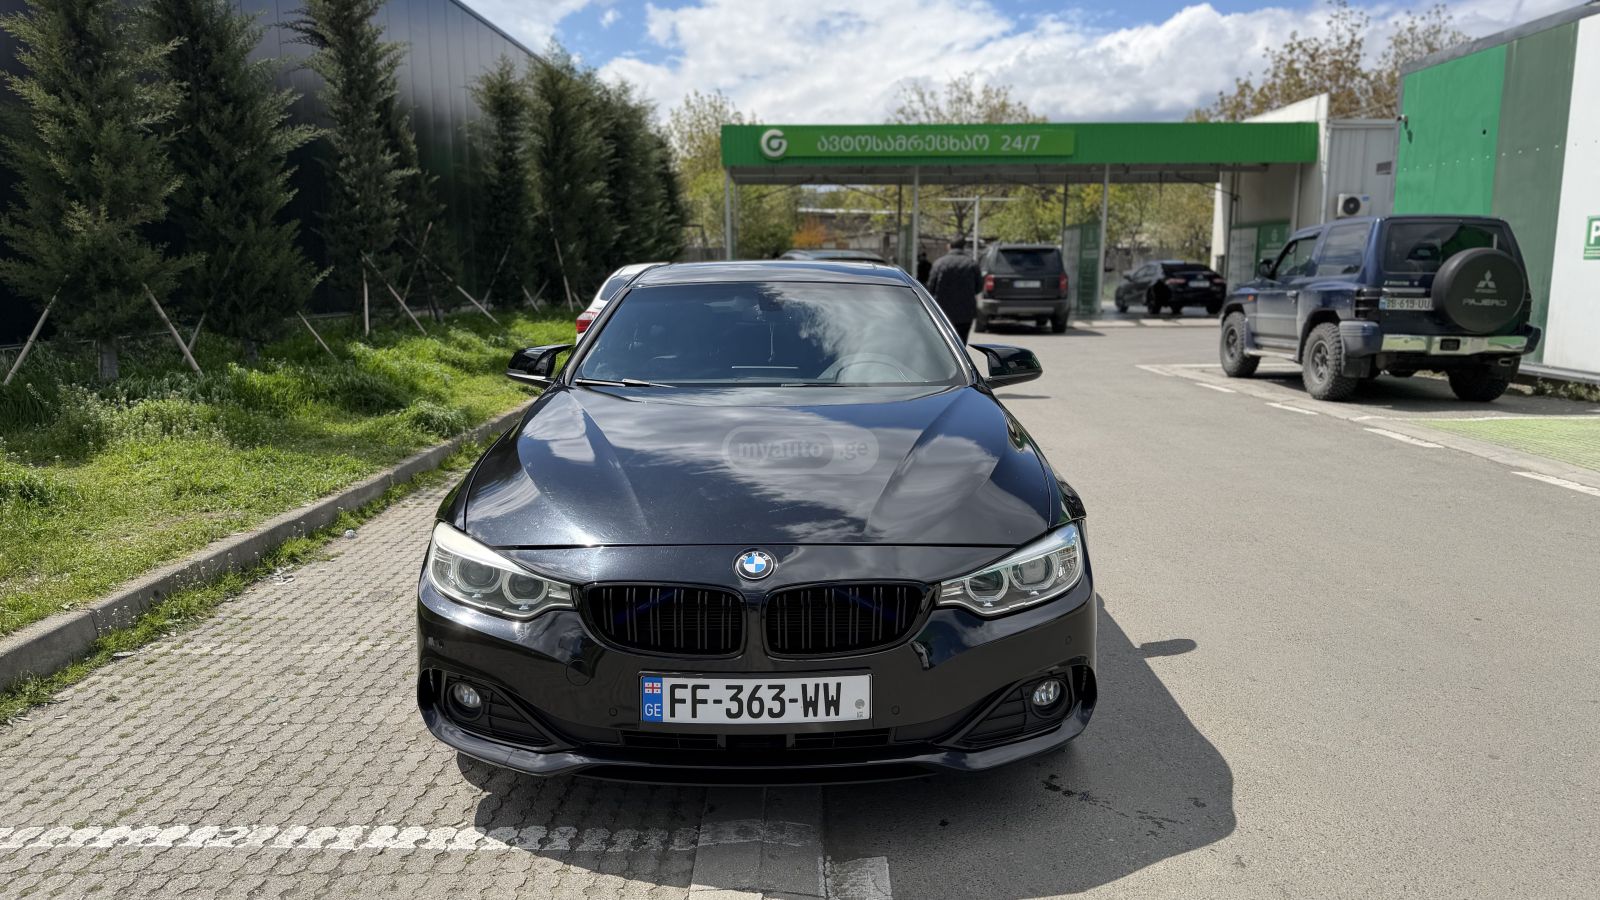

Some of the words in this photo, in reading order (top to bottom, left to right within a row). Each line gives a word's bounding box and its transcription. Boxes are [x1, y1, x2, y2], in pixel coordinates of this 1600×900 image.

[1000, 134, 1041, 153] 24/7
[644, 703, 662, 717] GE
[669, 682, 842, 719] FF-363-WW
